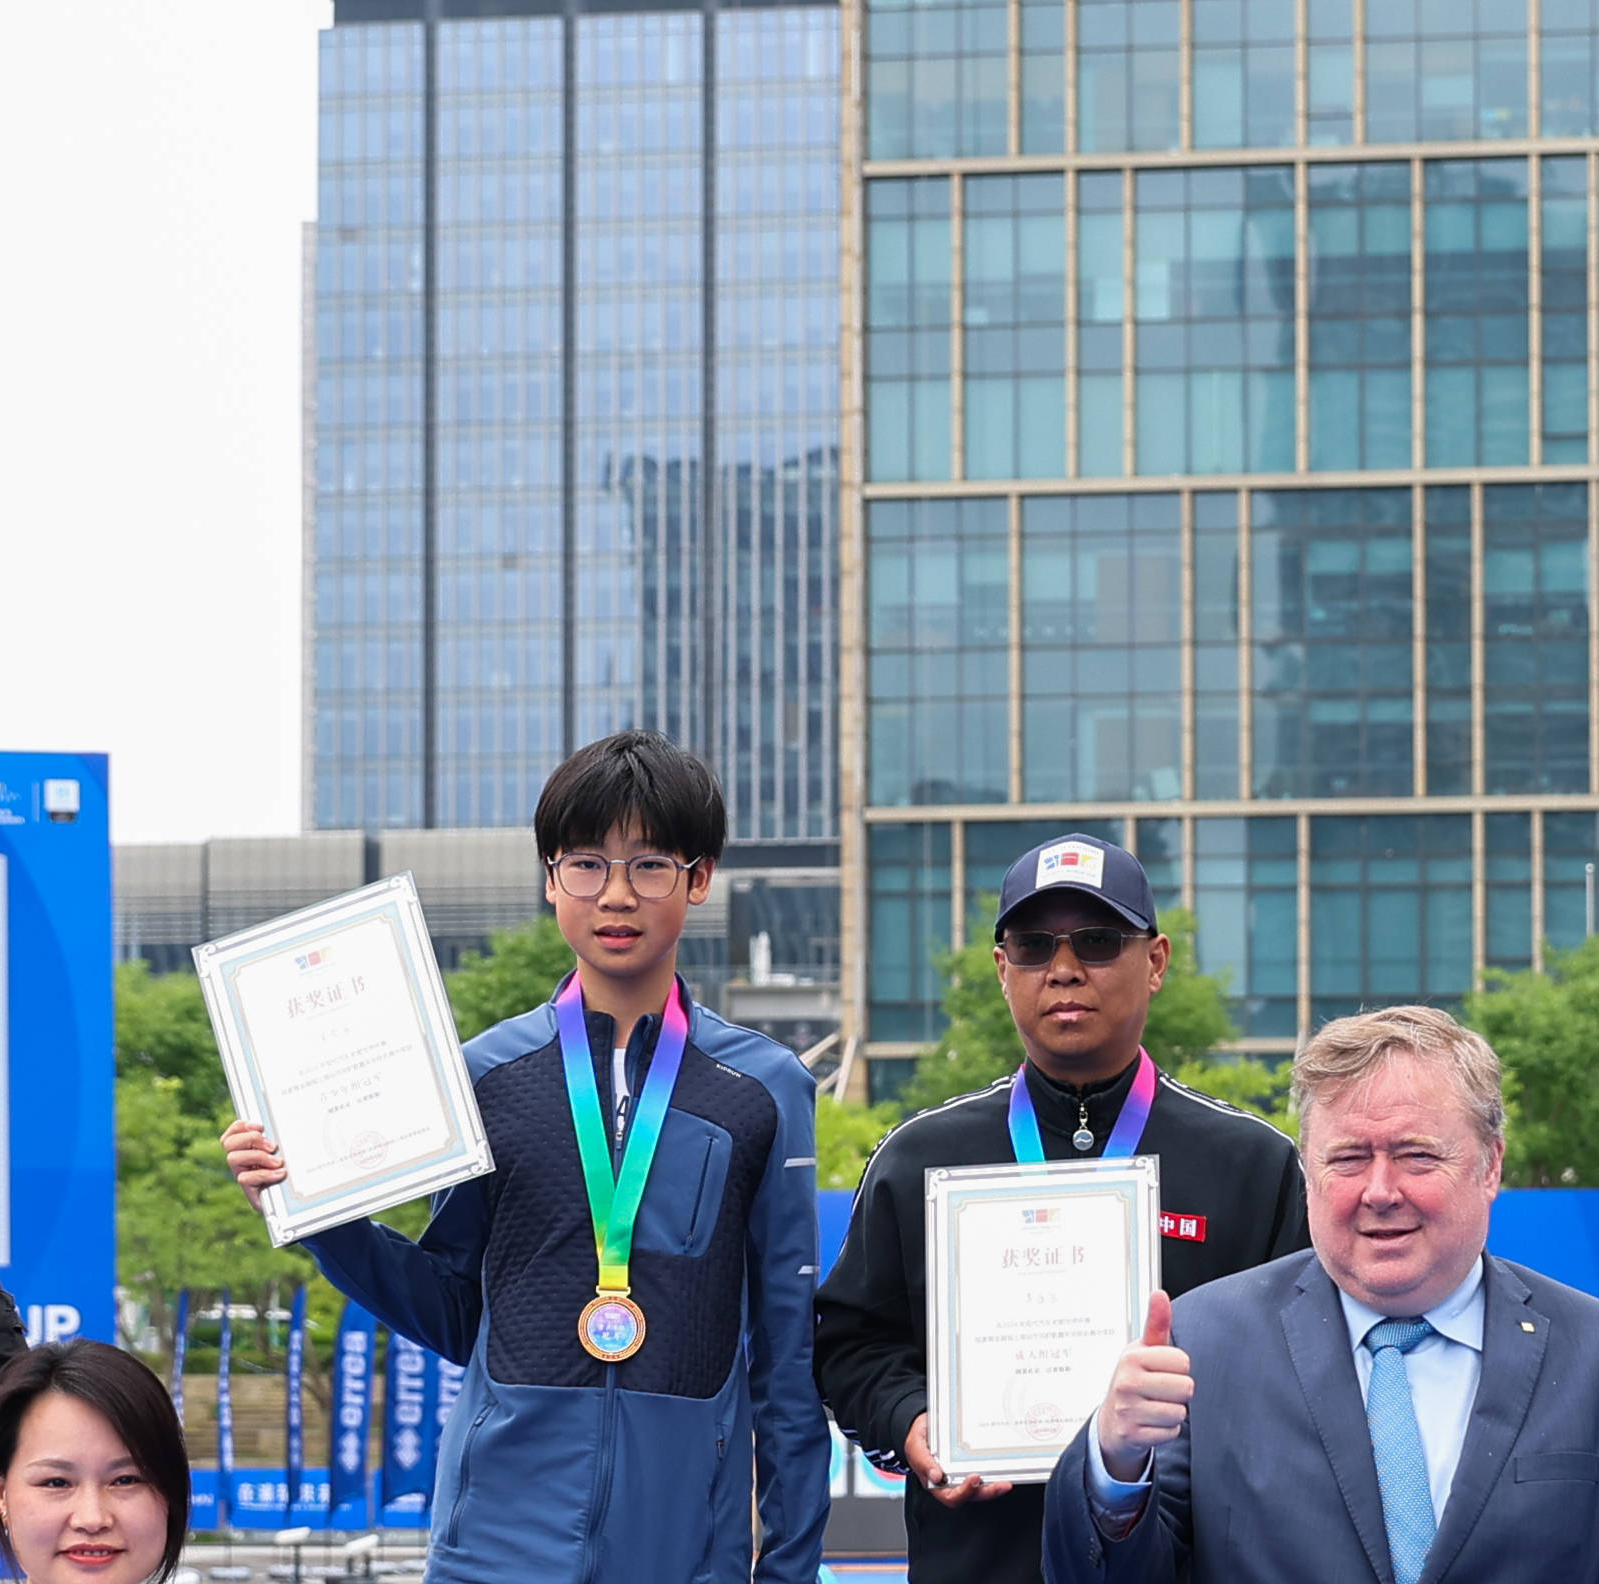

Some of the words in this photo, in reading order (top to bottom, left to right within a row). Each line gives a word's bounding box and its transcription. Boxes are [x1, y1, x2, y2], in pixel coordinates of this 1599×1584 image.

[287, 976, 366, 1018] 获奖证书
[1159, 1216, 1197, 1237] 中国
[1001, 1246, 1086, 1269] 获奖证书
